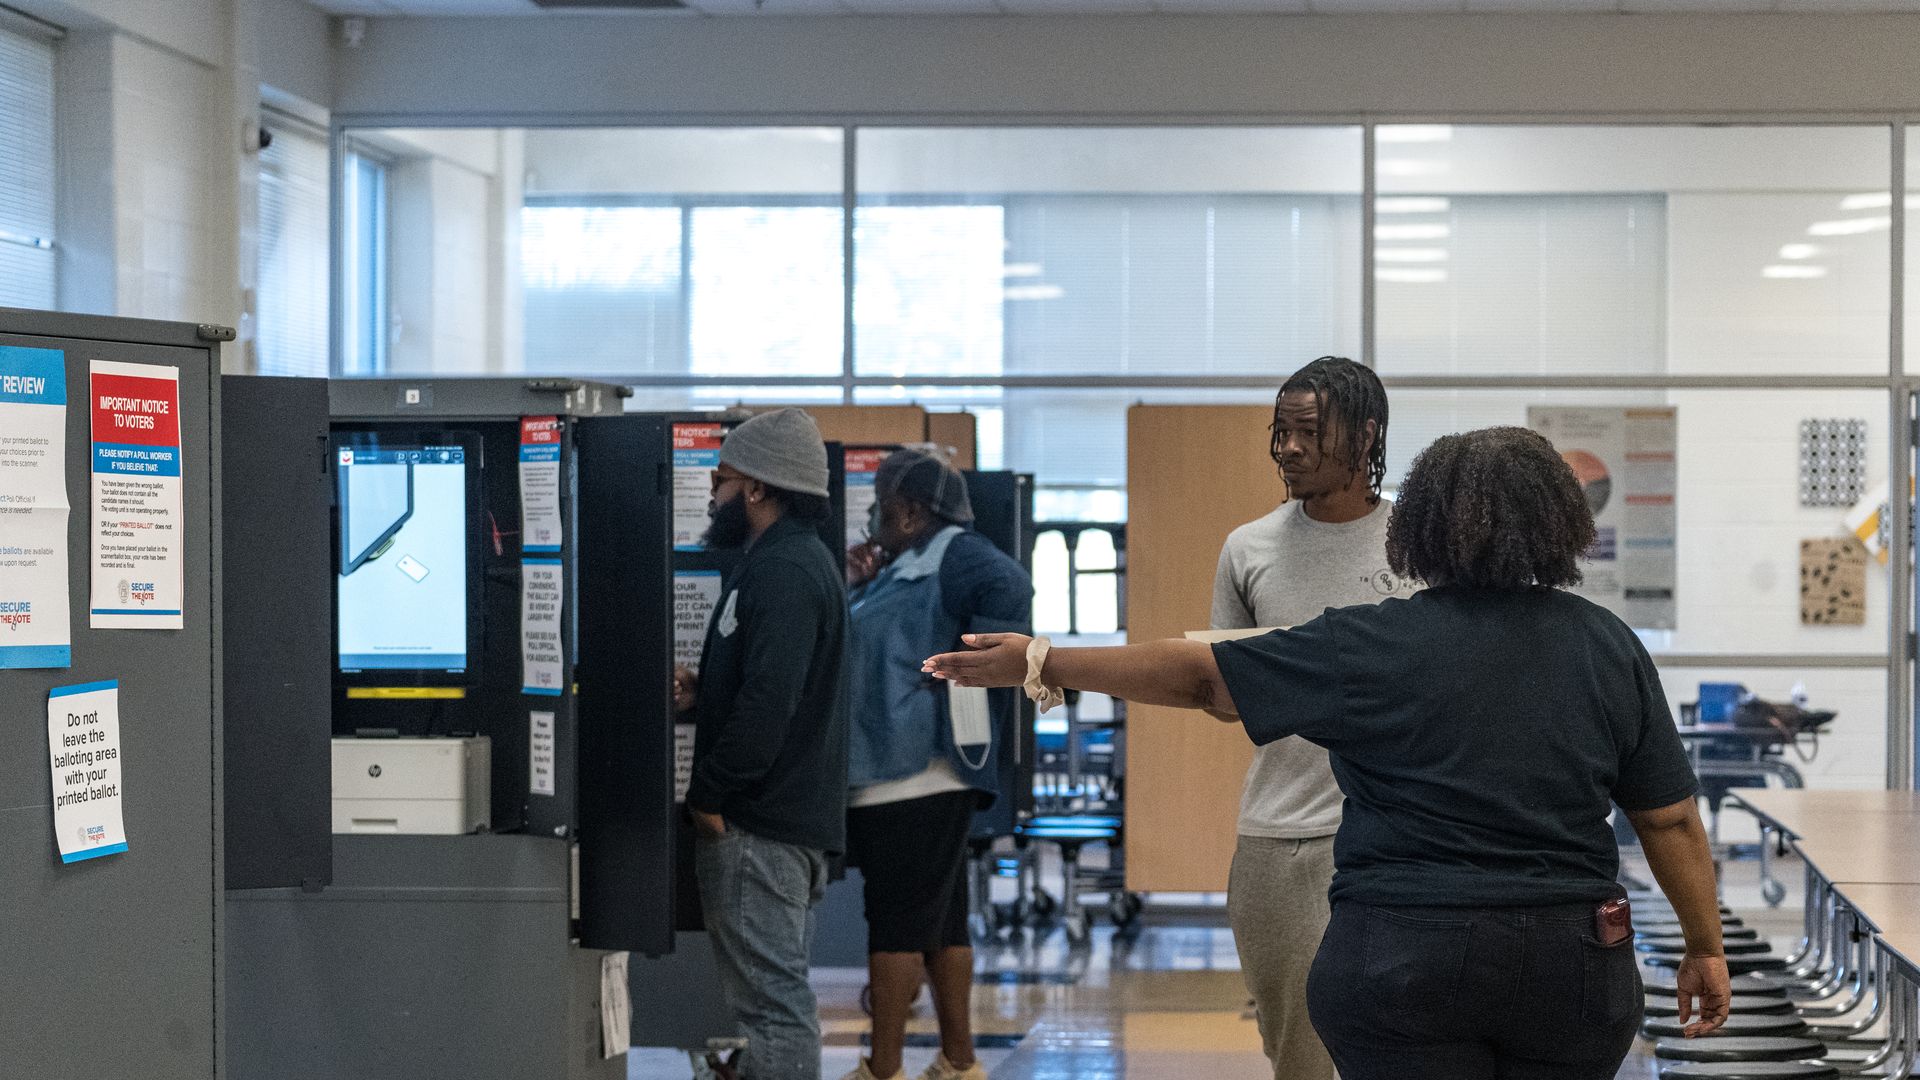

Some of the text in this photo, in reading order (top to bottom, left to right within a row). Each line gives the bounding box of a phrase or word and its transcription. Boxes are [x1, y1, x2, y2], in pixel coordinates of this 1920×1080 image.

[4, 376, 45, 394] REVIEW
[100, 396, 169, 414] IMPORTANT NOTICE
[114, 414, 154, 429] TO VOTERS
[673, 438, 694, 447] TERS
[99, 448, 117, 458] PLEASE
[118, 450, 133, 459] NOTIFY
[138, 452, 149, 460] POLL
[150, 452, 172, 461] WORKER
[127, 463, 145, 471] BELIEVE
[145, 464, 158, 472] THAT:
[131, 583, 154, 591] SECURE
[0, 602, 31, 612] SECURE
[0, 615, 12, 623] THE
[68, 710, 98, 727] Do not
[62, 728, 105, 747] leave the
[54, 748, 117, 768] balloting area
[65, 769, 107, 786] with your
[57, 784, 118, 811] printed ballot.
